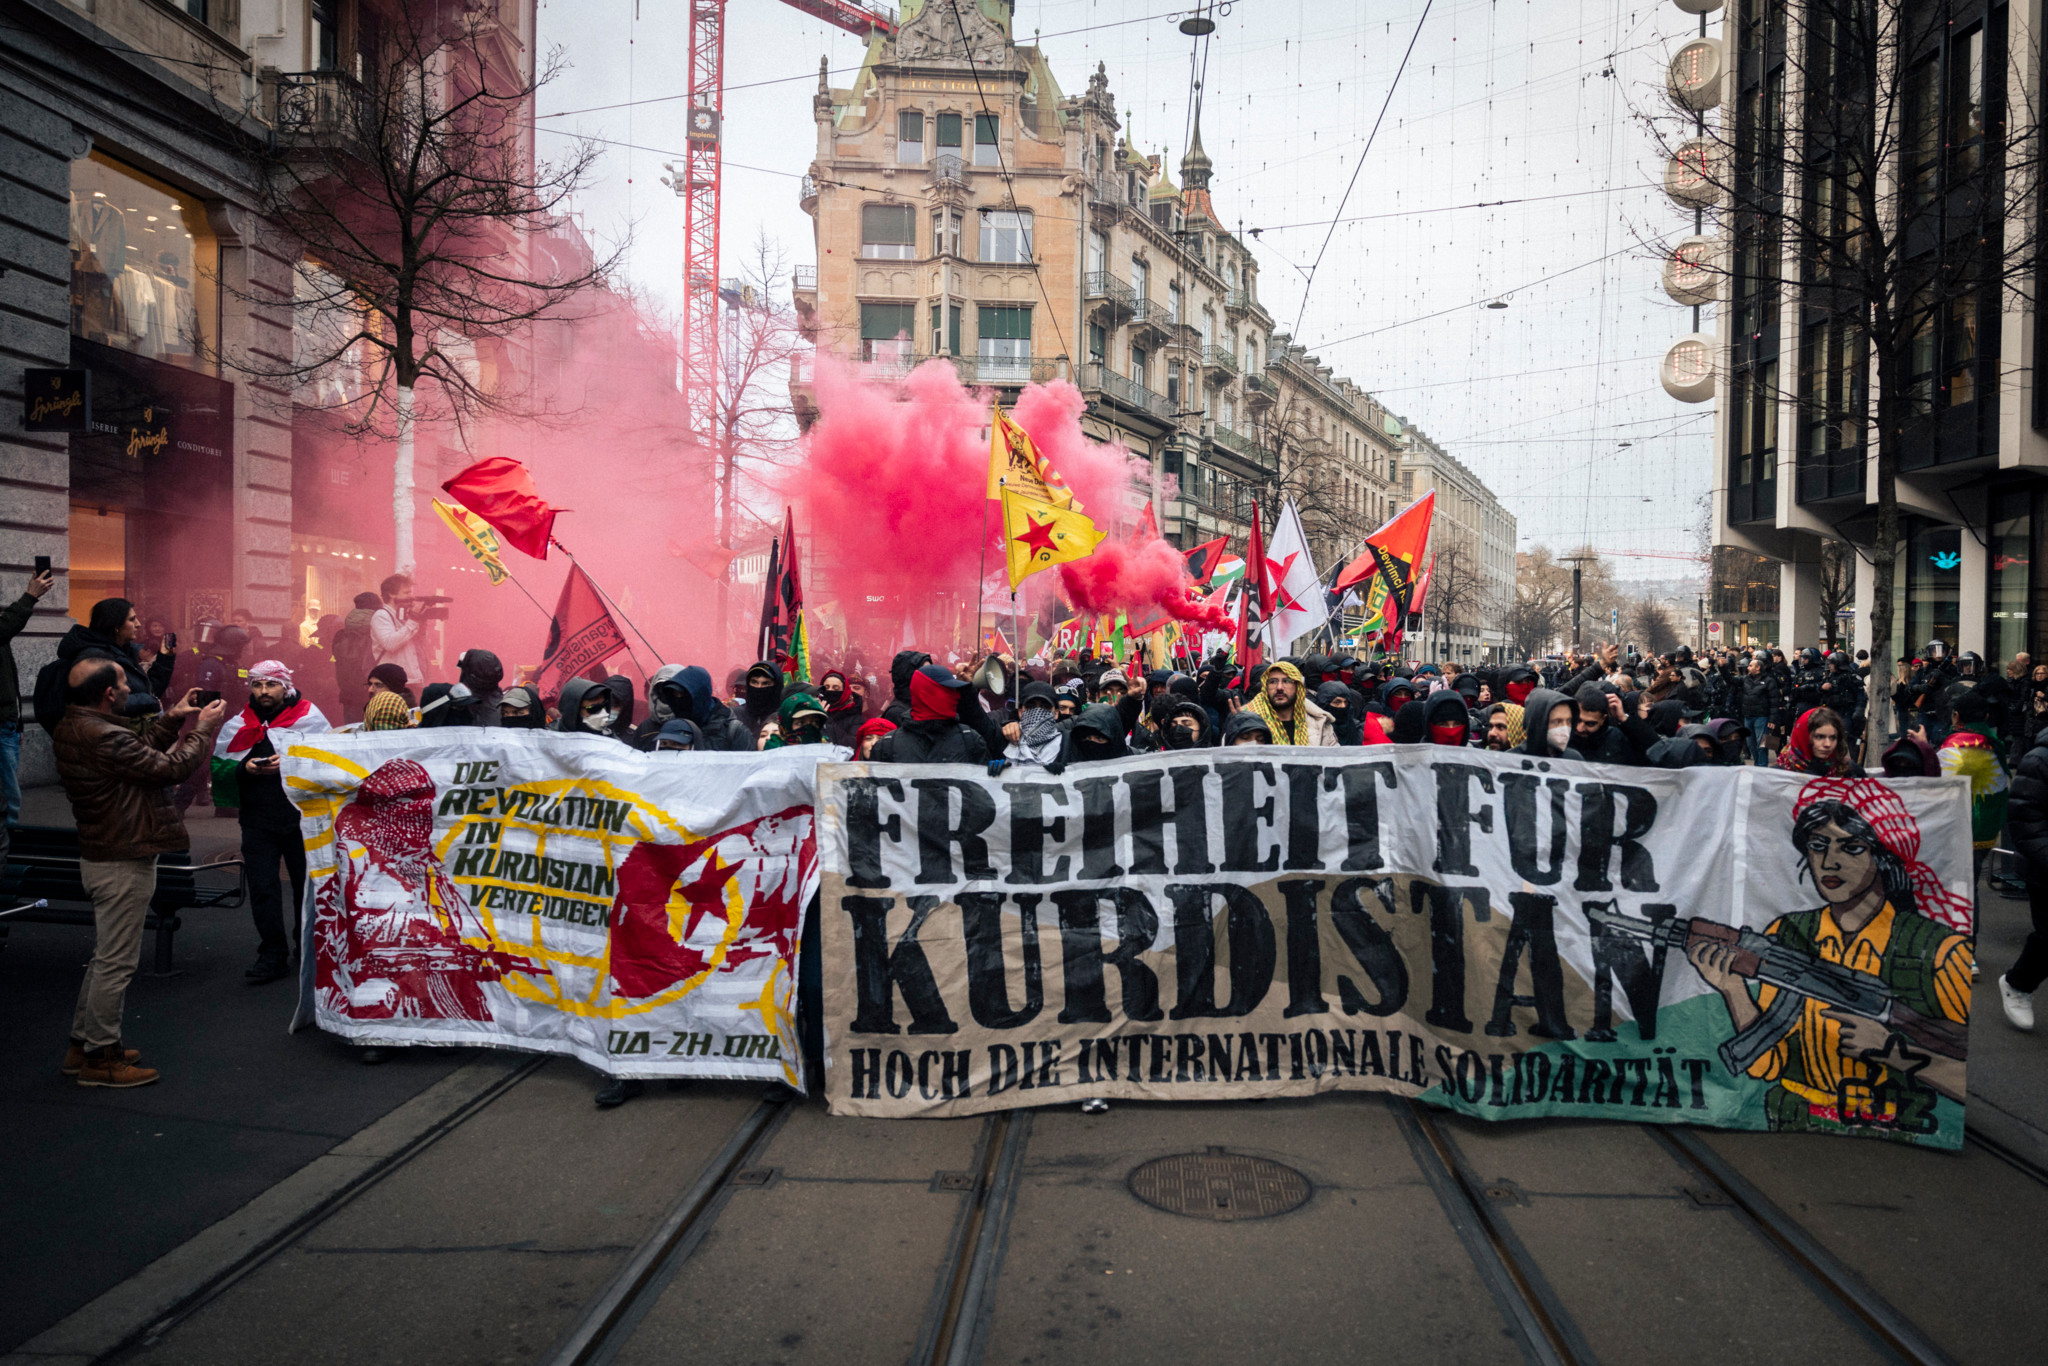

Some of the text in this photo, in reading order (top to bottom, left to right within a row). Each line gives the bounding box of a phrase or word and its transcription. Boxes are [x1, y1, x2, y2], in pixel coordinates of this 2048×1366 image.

[30, 390, 82, 422] Sprüngli
[126, 427, 169, 458] Sprüngli
[177, 441, 222, 457] CONDITOREI
[1377, 544, 1406, 589] Devrimci
[452, 760, 499, 785] DIE
[437, 787, 632, 833] REVOLUTION
[839, 759, 1660, 893] FREIHEIT FÜR
[464, 822, 502, 844] IN
[452, 848, 614, 897] KURDISTAN
[470, 884, 611, 928] VERTEIDIGEN
[841, 877, 1677, 1043] KURDISTAN
[850, 1027, 1712, 1111] HOCH DIE INTERNATIONALE SOLIDARITÄT
